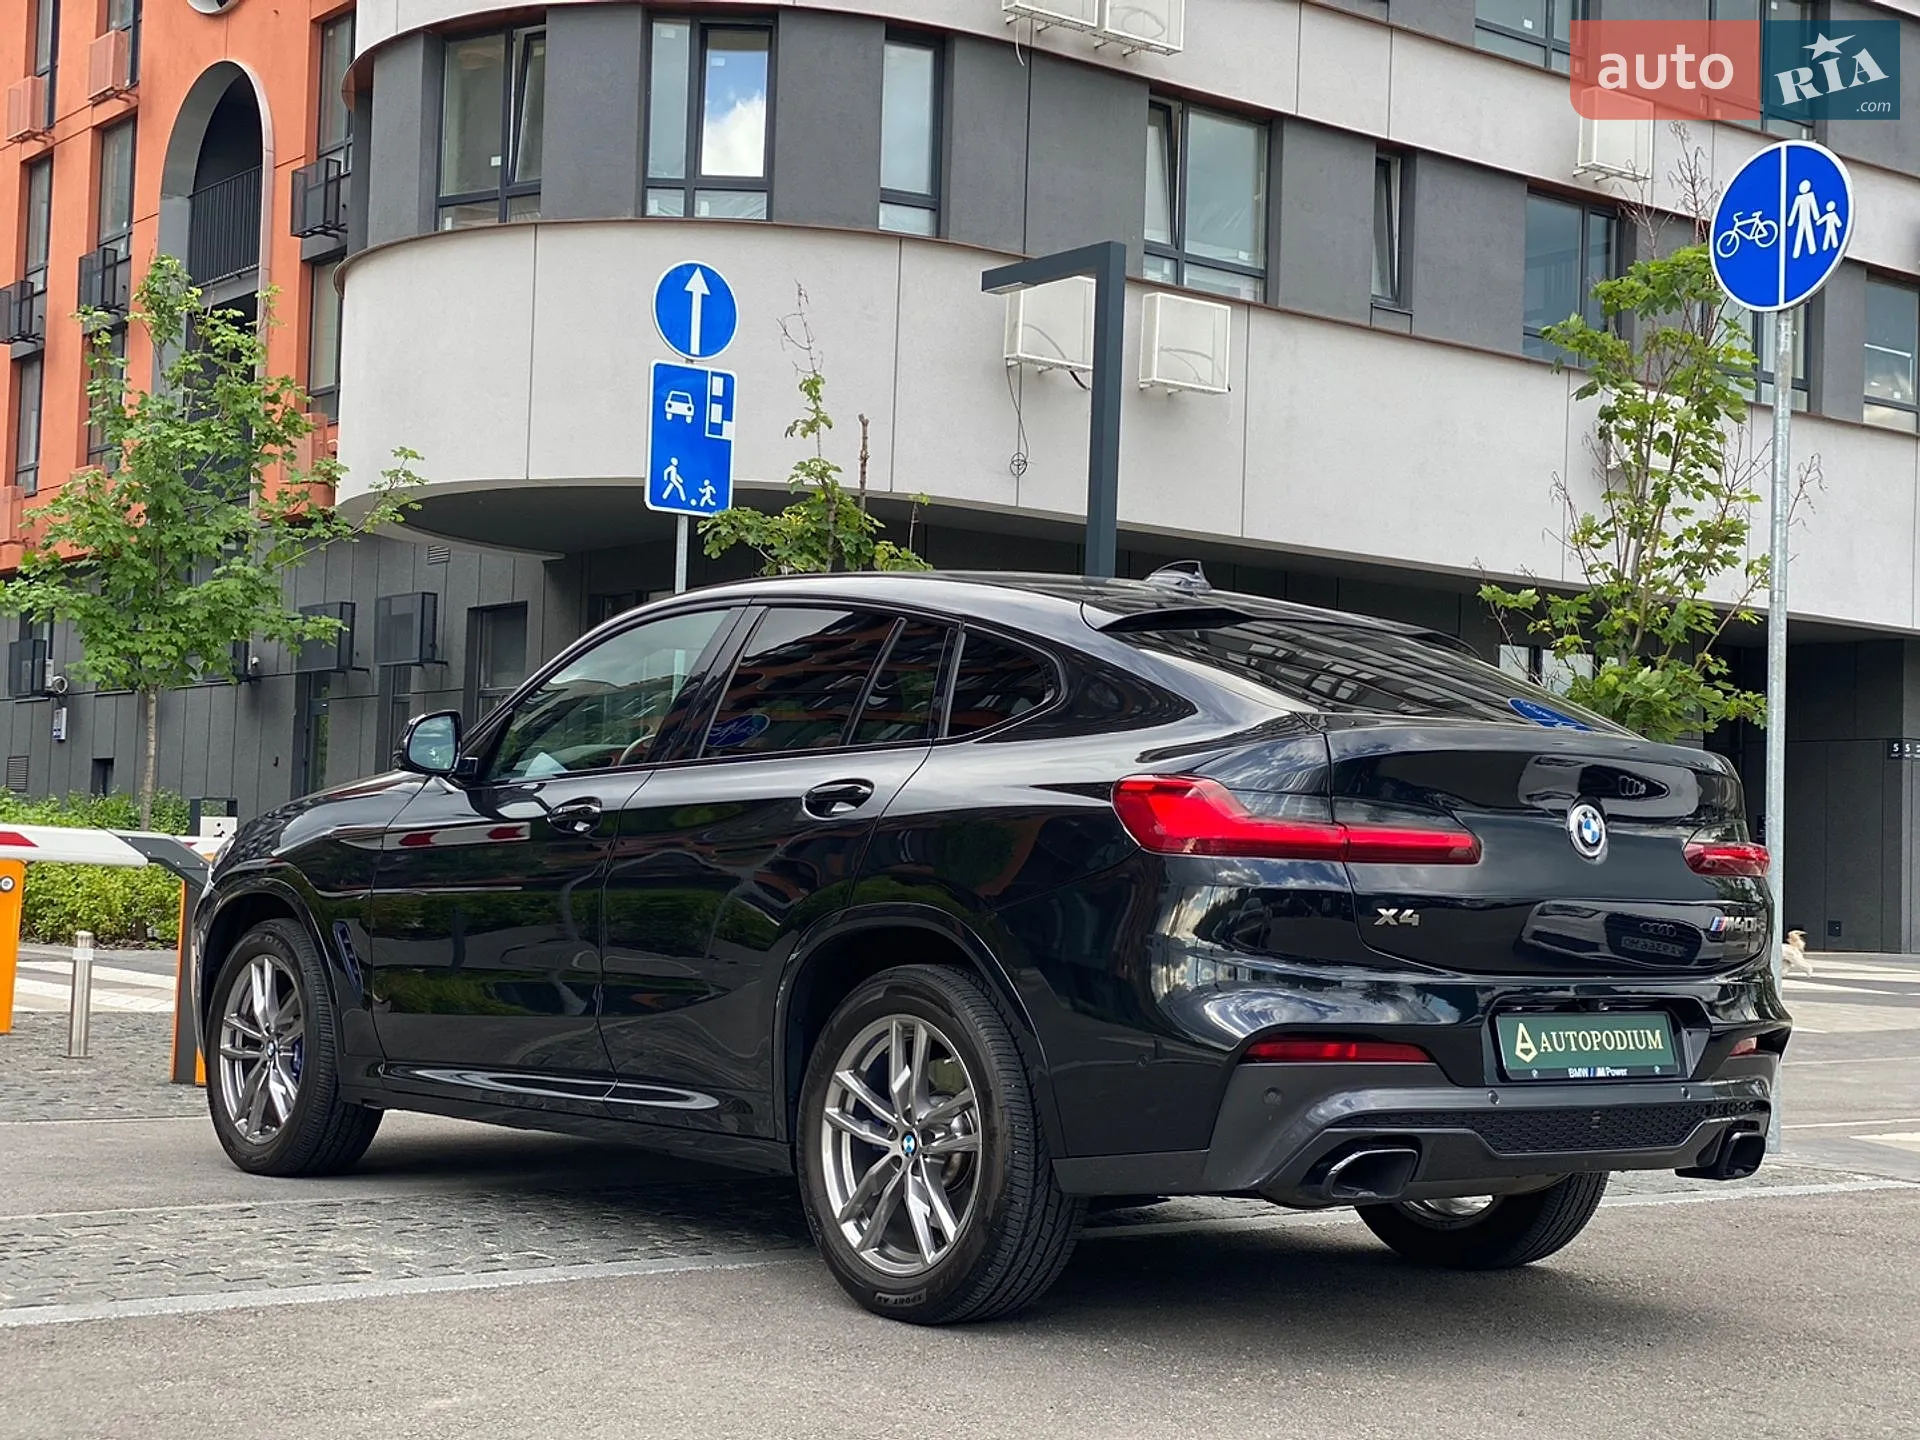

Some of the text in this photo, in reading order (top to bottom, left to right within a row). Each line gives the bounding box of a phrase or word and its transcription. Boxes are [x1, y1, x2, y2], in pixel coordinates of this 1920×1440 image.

[1374, 908, 1420, 926] X4
[1540, 1029, 1664, 1052] AUTOPODIUM
[1568, 1067, 1589, 1078] BMW
